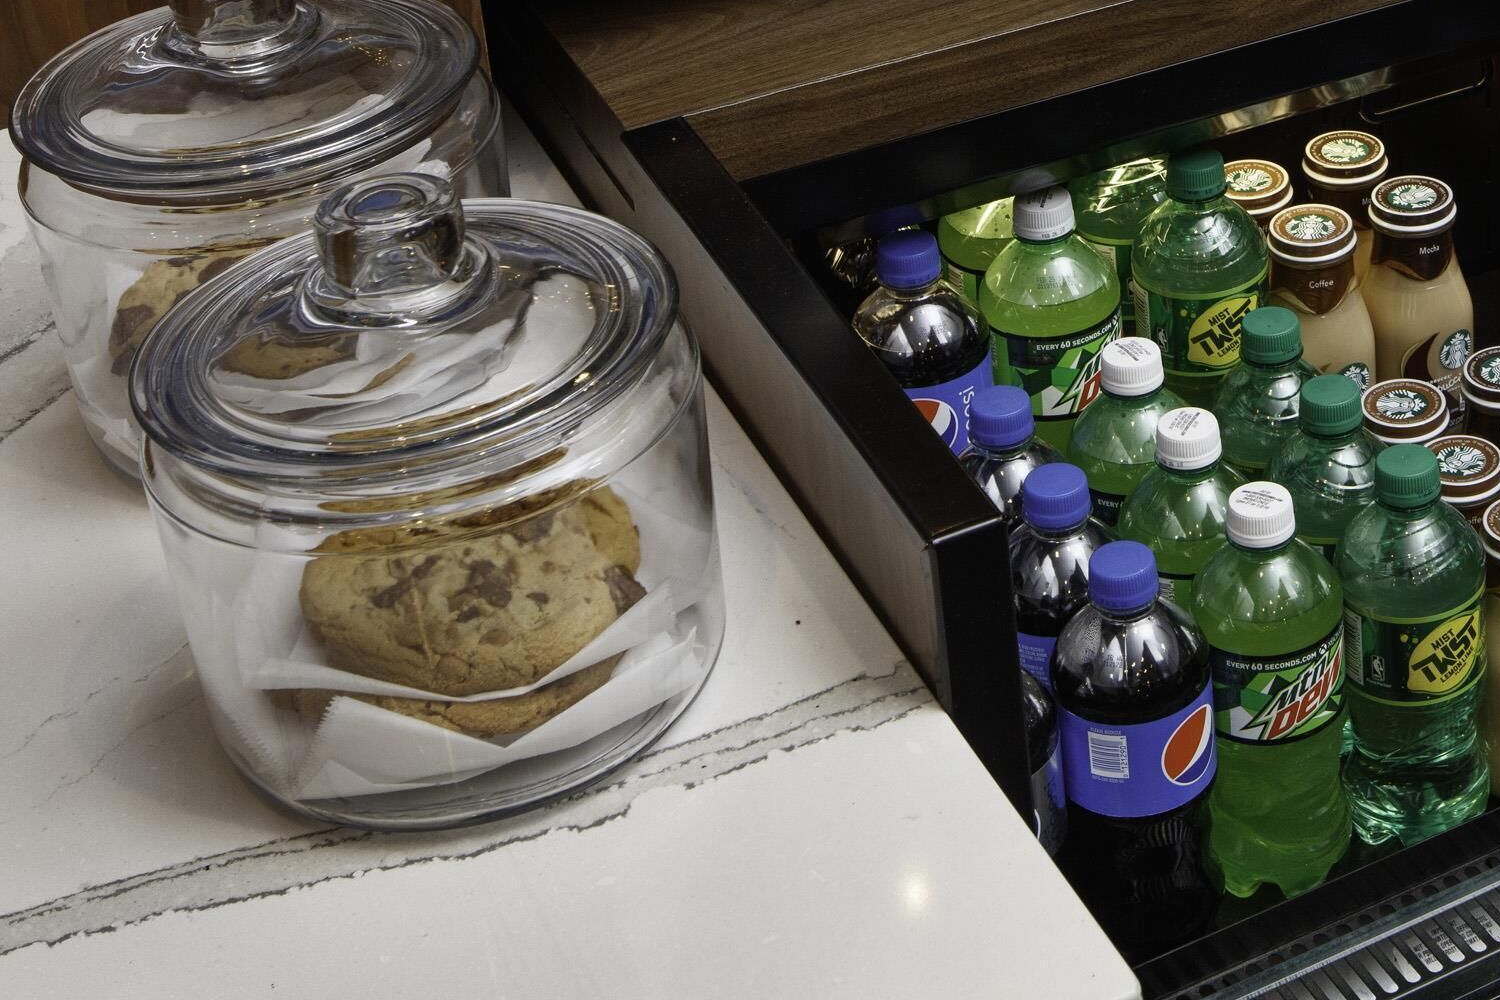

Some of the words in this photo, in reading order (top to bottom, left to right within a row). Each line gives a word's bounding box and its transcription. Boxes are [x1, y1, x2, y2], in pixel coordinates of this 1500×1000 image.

[1419, 244, 1440, 256] Mocha
[1309, 279, 1334, 290] Coffee
[1208, 308, 1230, 327] MIST
[1036, 344, 1060, 352] EVERY
[1060, 340, 1072, 350] 60
[1072, 322, 1112, 347] SECONDS.COM
[1097, 498, 1119, 509] EVERY
[1431, 628, 1455, 651] MIST
[1226, 659, 1250, 671] EVERY
[1251, 663, 1263, 671] 60
[1264, 653, 1317, 671] SECONDS.COM
[1440, 659, 1463, 683] LEMON
[1461, 645, 1475, 663] LIME
